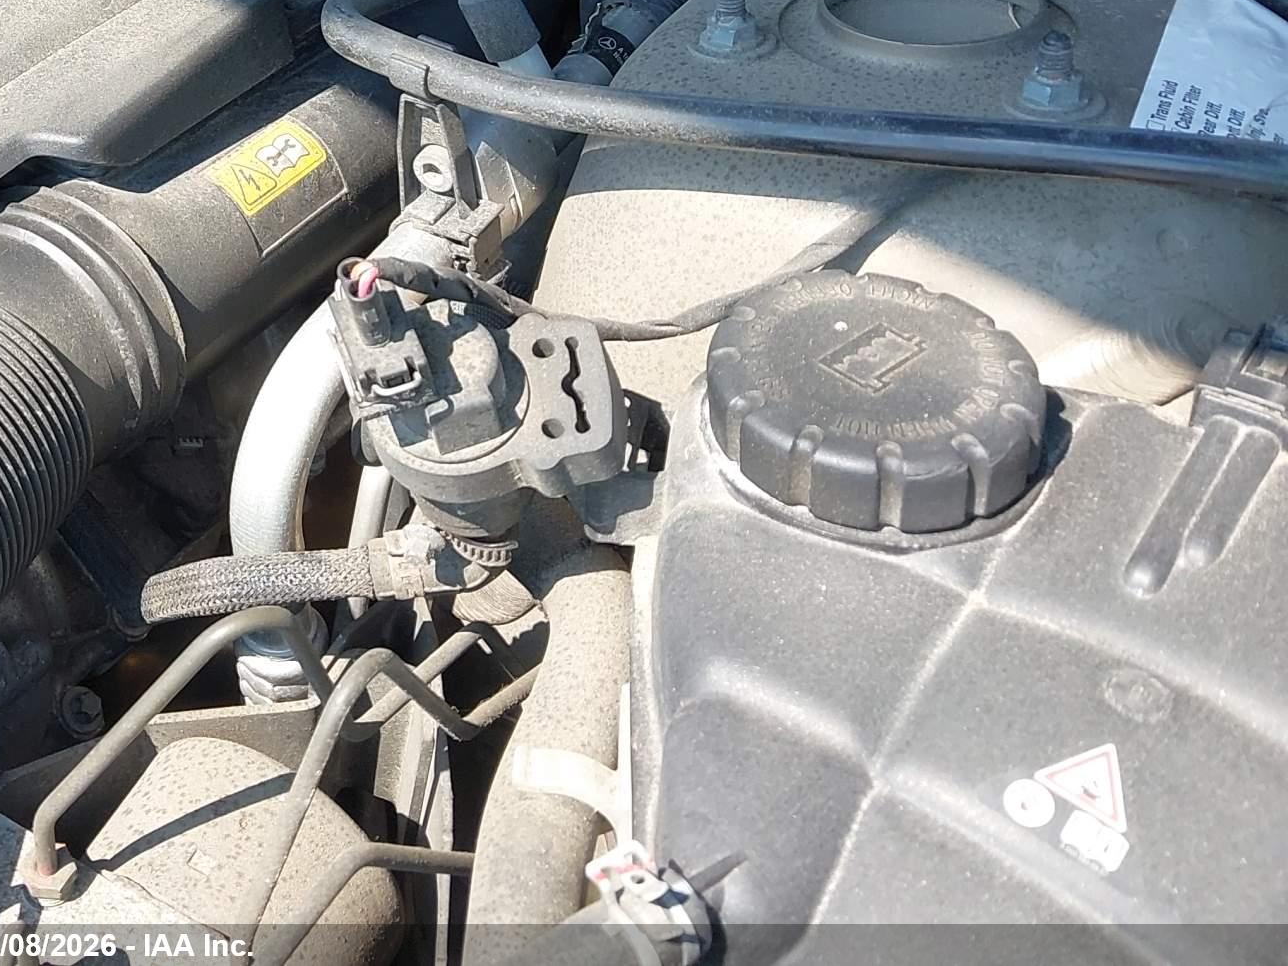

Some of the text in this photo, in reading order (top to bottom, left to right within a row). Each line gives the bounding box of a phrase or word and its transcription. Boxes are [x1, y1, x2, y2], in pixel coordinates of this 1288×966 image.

[1151, 79, 1178, 121] Trans Fluid
[1175, 84, 1202, 129] Cabin Filter
[1204, 100, 1223, 119] Diff.
[1227, 108, 1245, 126] Diff.
